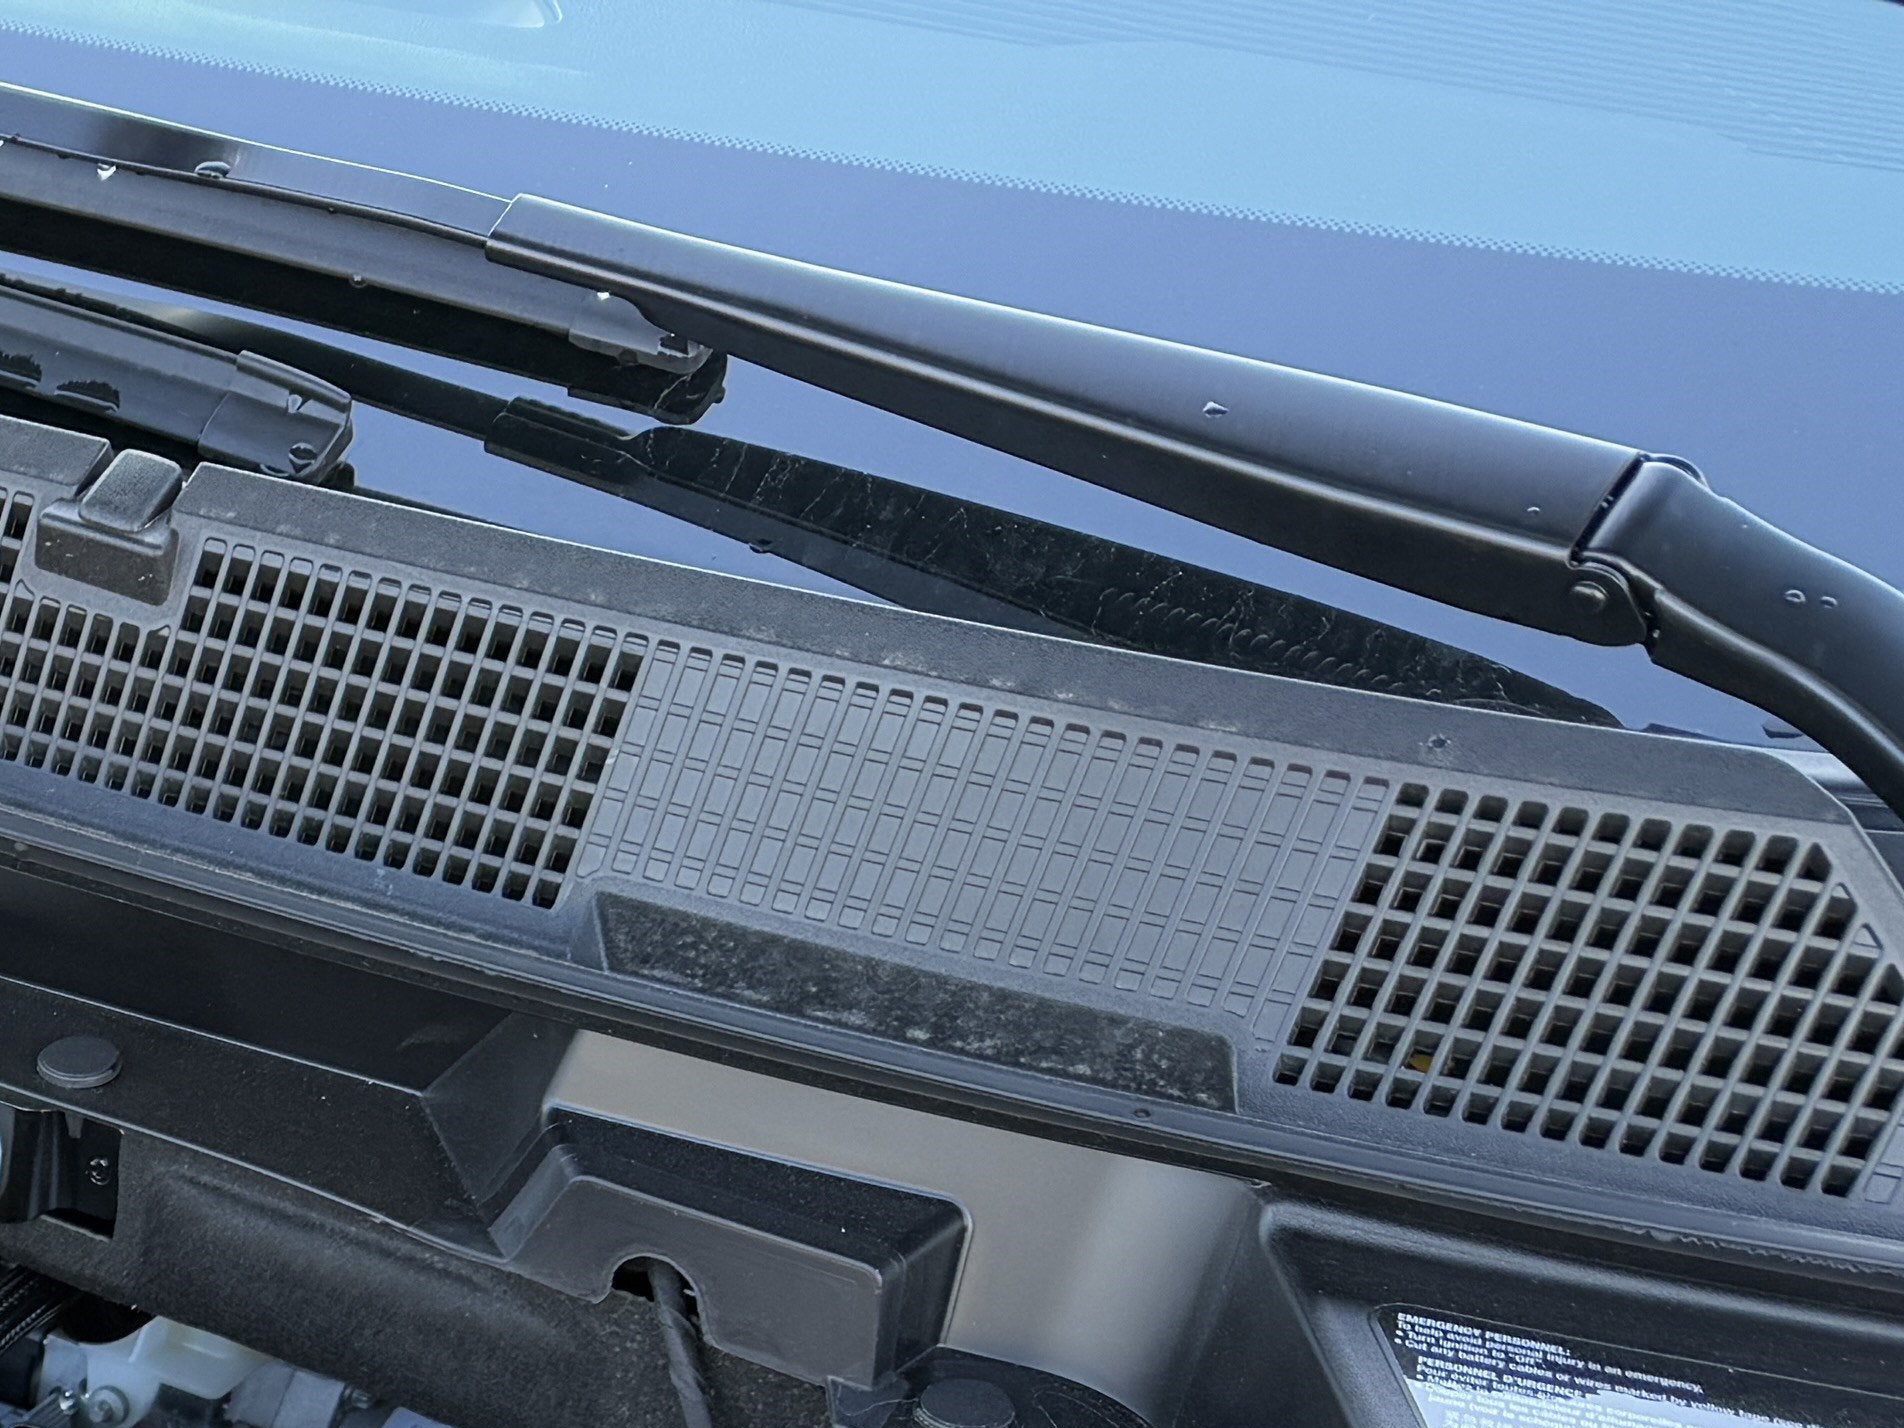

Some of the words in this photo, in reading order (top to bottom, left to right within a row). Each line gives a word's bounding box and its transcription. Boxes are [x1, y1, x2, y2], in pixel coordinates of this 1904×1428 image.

[1396, 1319, 1412, 1331] To
[1413, 1323, 1443, 1338] help
[1445, 1329, 1482, 1346] avoid
[1485, 1338, 1542, 1361] personal
[1546, 1352, 1585, 1370] injury
[1397, 1311, 1482, 1339] EMERGENCY
[1485, 1329, 1570, 1357] PERSONNEL:
[1407, 1330, 1437, 1344] Turn
[1438, 1336, 1489, 1357] ignition
[1405, 1338, 1428, 1351] Cut
[1430, 1344, 1455, 1358] any
[1457, 1349, 1506, 1369] battery
[1508, 1360, 1553, 1378] cables
[1573, 1374, 1612, 1391] wires
[1415, 1363, 1445, 1378] Pour
[1417, 1354, 1500, 1381] PERSONNEL
